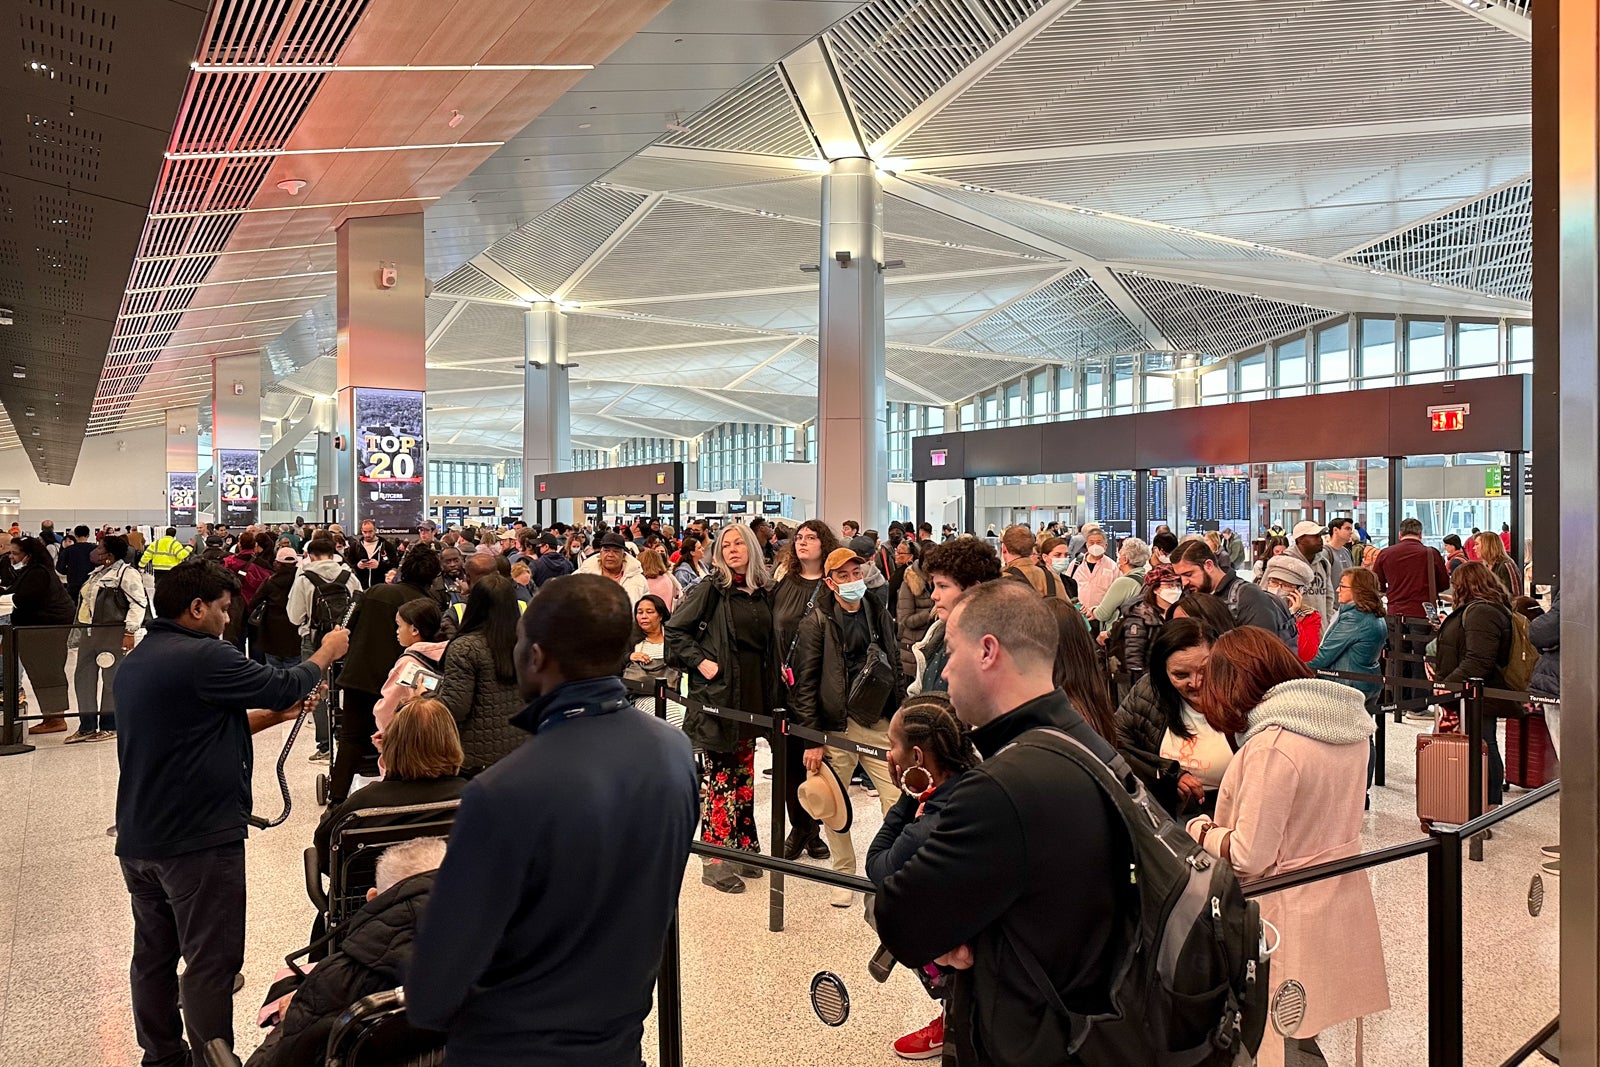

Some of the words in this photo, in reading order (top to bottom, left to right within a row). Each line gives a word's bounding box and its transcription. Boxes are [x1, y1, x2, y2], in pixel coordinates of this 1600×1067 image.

[365, 435, 416, 453] TOP
[370, 453, 414, 478] 20
[225, 474, 254, 485] TOP
[172, 489, 193, 497] TOP
[227, 484, 254, 500] 20
[174, 496, 193, 507] 20
[1530, 695, 1555, 703] Terminal
[856, 744, 874, 755] Terminal
